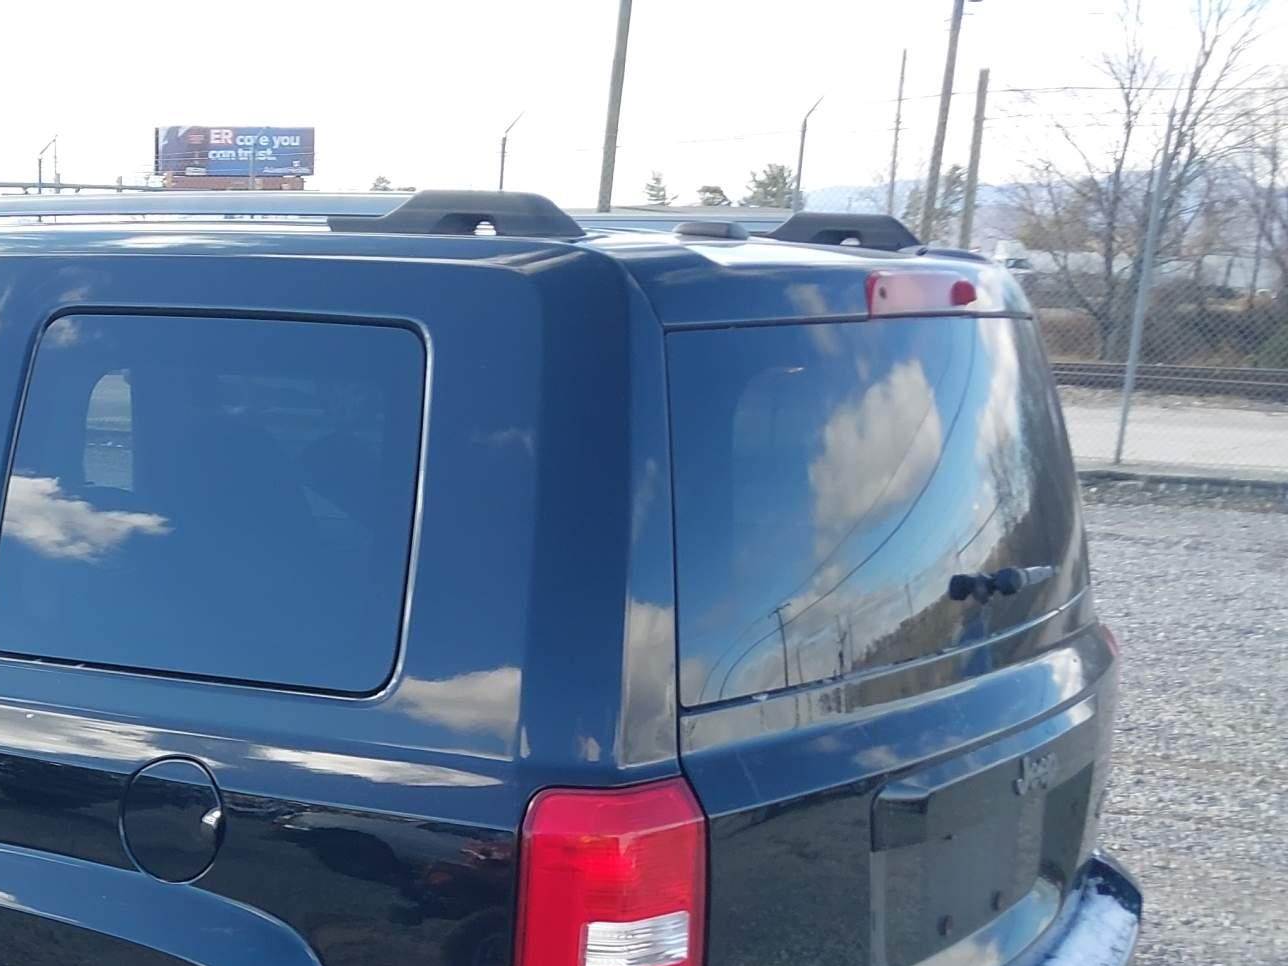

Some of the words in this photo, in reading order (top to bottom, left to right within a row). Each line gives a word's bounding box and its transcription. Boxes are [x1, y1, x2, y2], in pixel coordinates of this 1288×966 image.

[210, 129, 233, 144] ER
[273, 135, 300, 149] you
[208, 150, 236, 160] can
